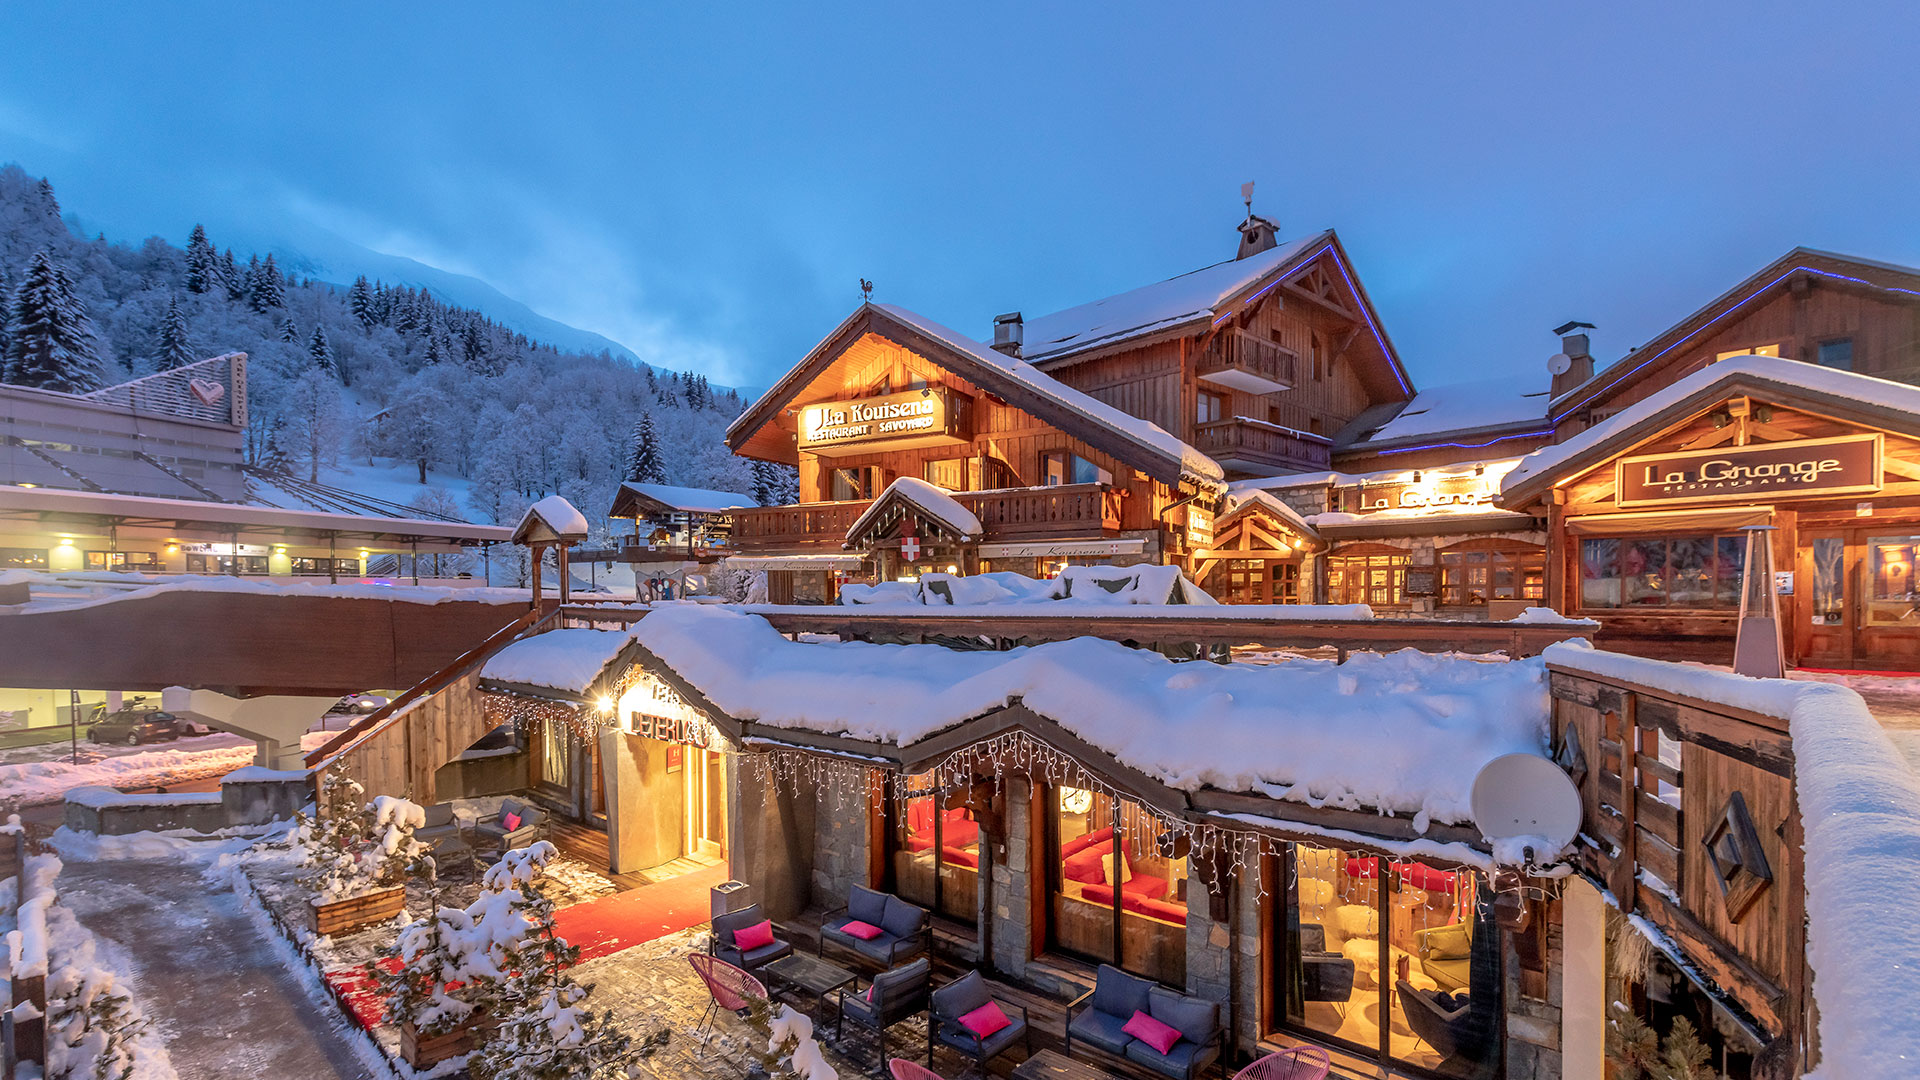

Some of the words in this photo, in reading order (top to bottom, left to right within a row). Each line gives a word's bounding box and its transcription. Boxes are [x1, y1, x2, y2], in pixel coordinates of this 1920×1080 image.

[823, 408, 846, 426] La
[850, 400, 933, 422] Kouisena
[808, 425, 870, 441] RESTAURANT
[879, 417, 934, 432] SAVOYARD
[1642, 466, 1686, 486] La
[1698, 459, 1843, 482] Grange
[1663, 476, 1799, 491] RESTAURANT
[1359, 493, 1389, 510] La
